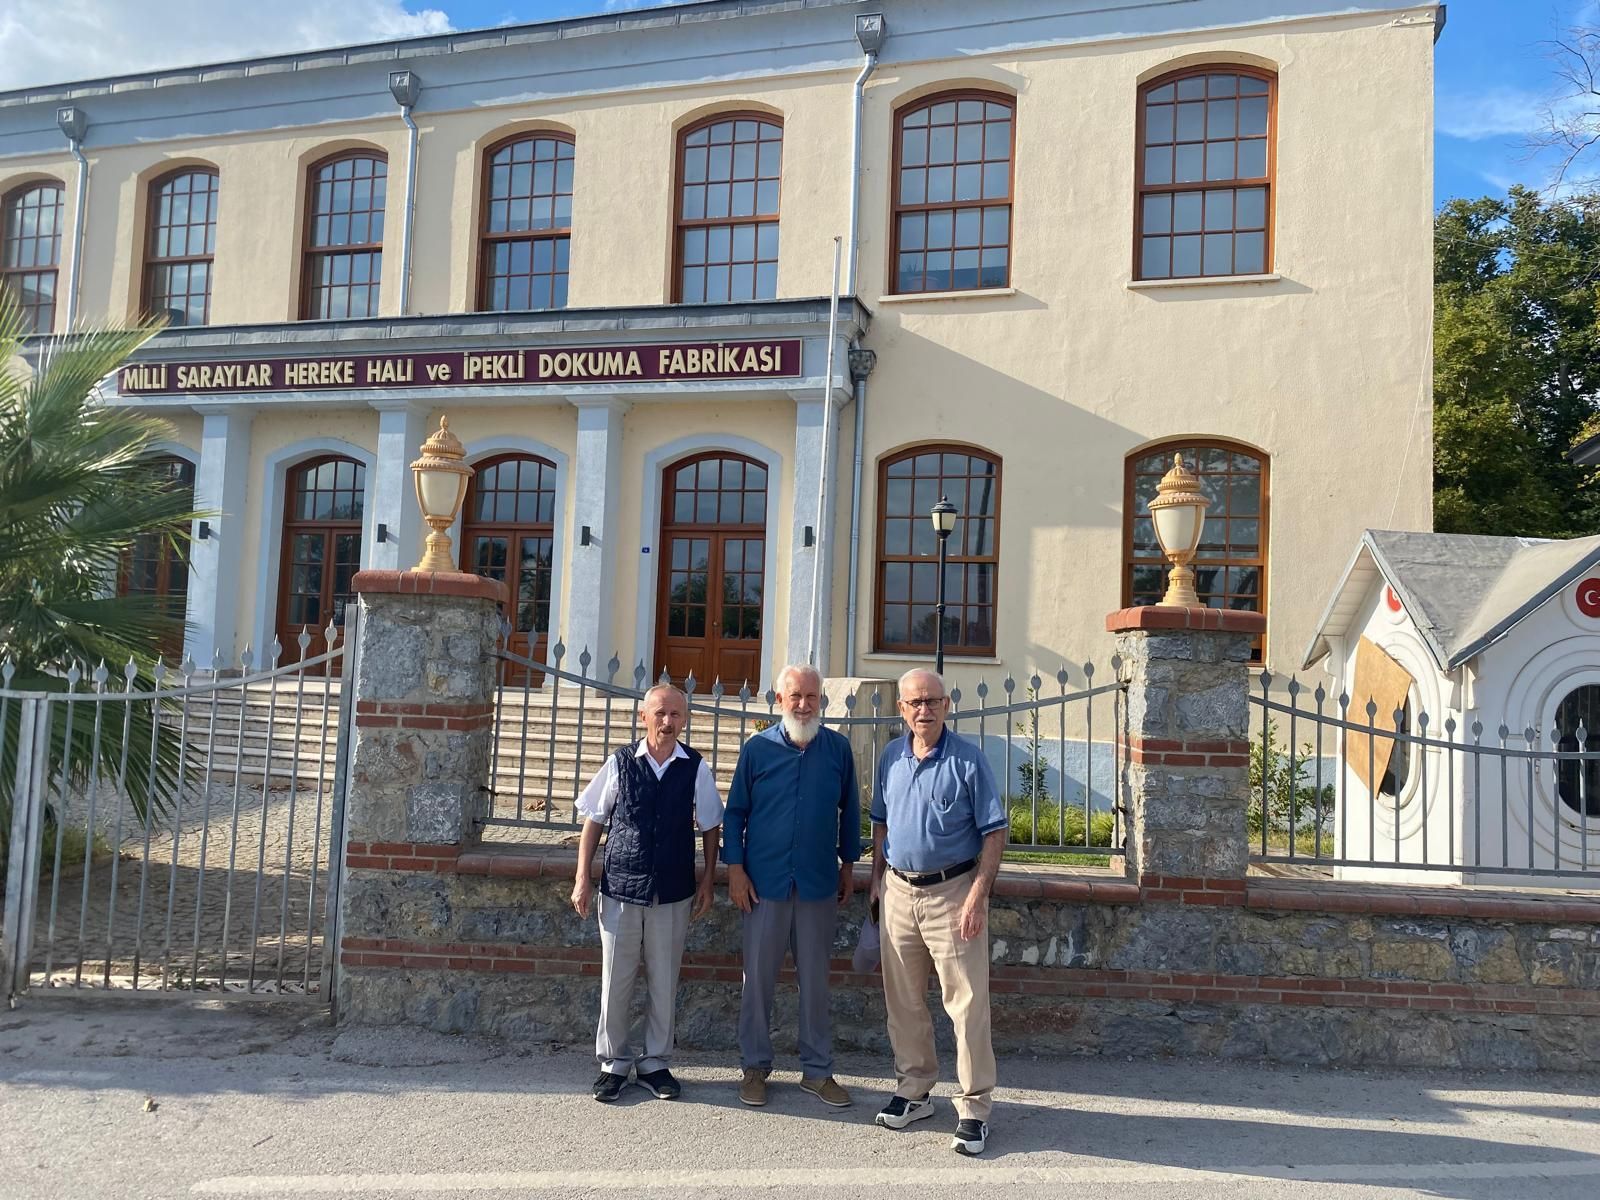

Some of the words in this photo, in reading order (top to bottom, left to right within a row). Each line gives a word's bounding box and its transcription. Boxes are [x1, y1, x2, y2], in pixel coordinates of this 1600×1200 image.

[122, 364, 167, 391] MİLLİ
[177, 363, 273, 389] SARAYLAR
[284, 360, 355, 385] HEREKE
[366, 358, 414, 382] HALI
[426, 363, 452, 381] ve
[463, 350, 526, 381] İPEKLİ
[538, 350, 643, 378] DOKUMA
[659, 343, 782, 375] FABRİKASI
